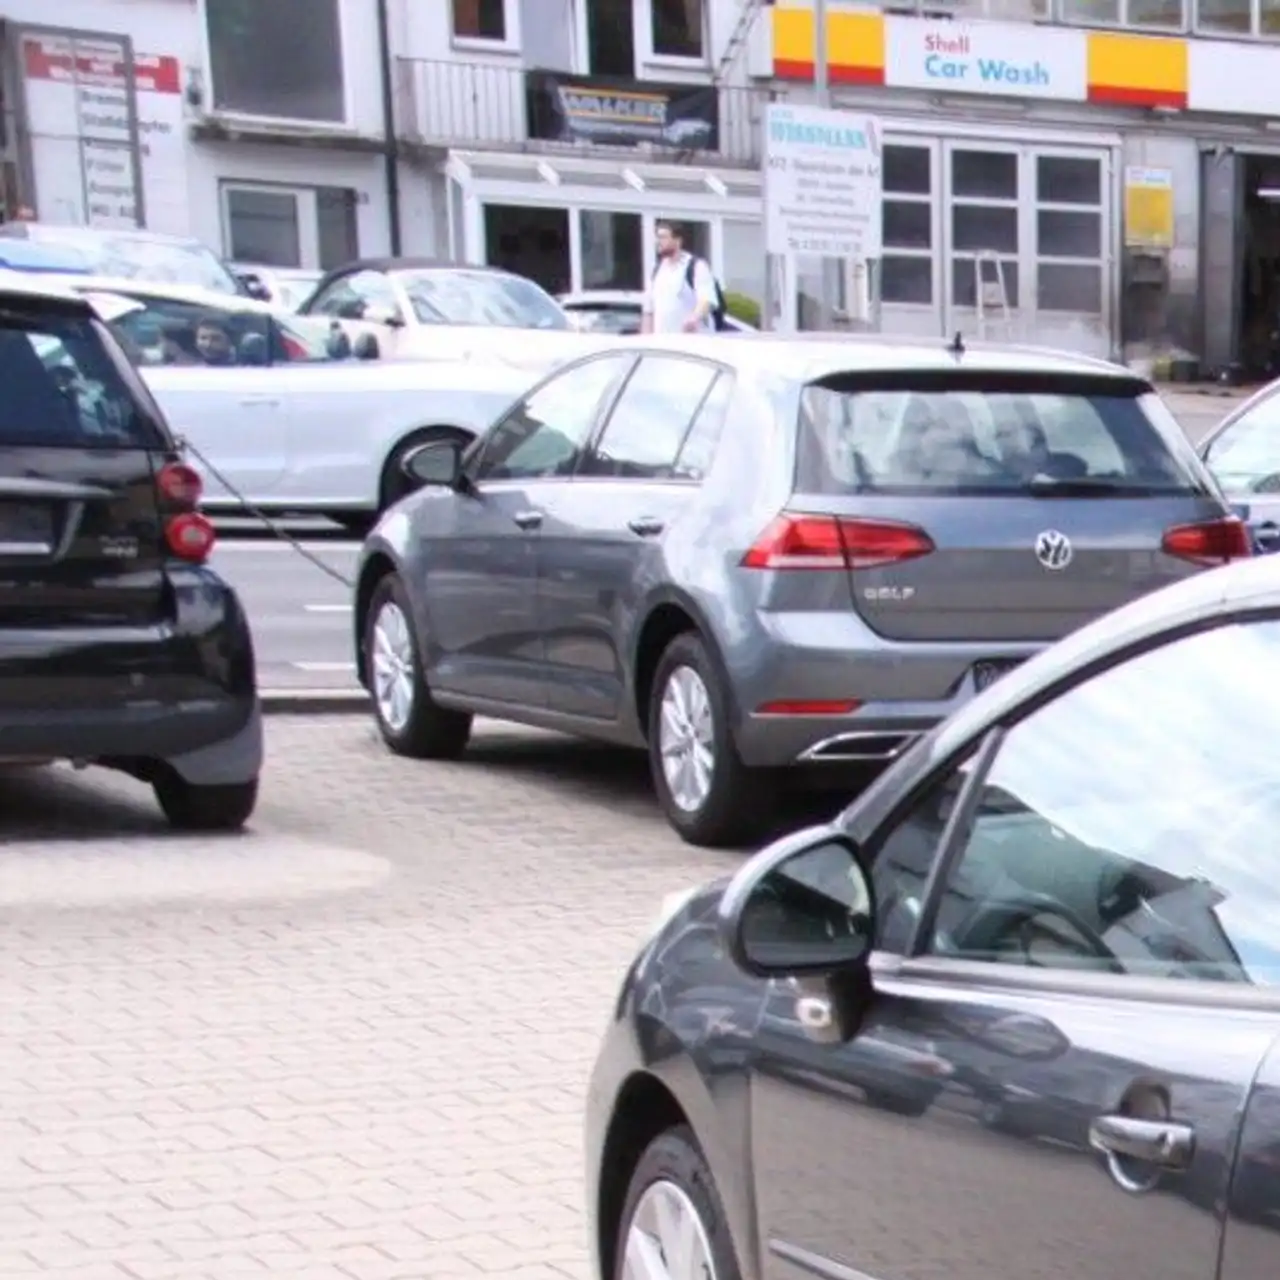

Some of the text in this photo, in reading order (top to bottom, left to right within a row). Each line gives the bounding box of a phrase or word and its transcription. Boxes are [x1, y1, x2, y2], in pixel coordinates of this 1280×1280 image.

[924, 31, 970, 54] Shell
[925, 54, 1050, 86] Car Wash
